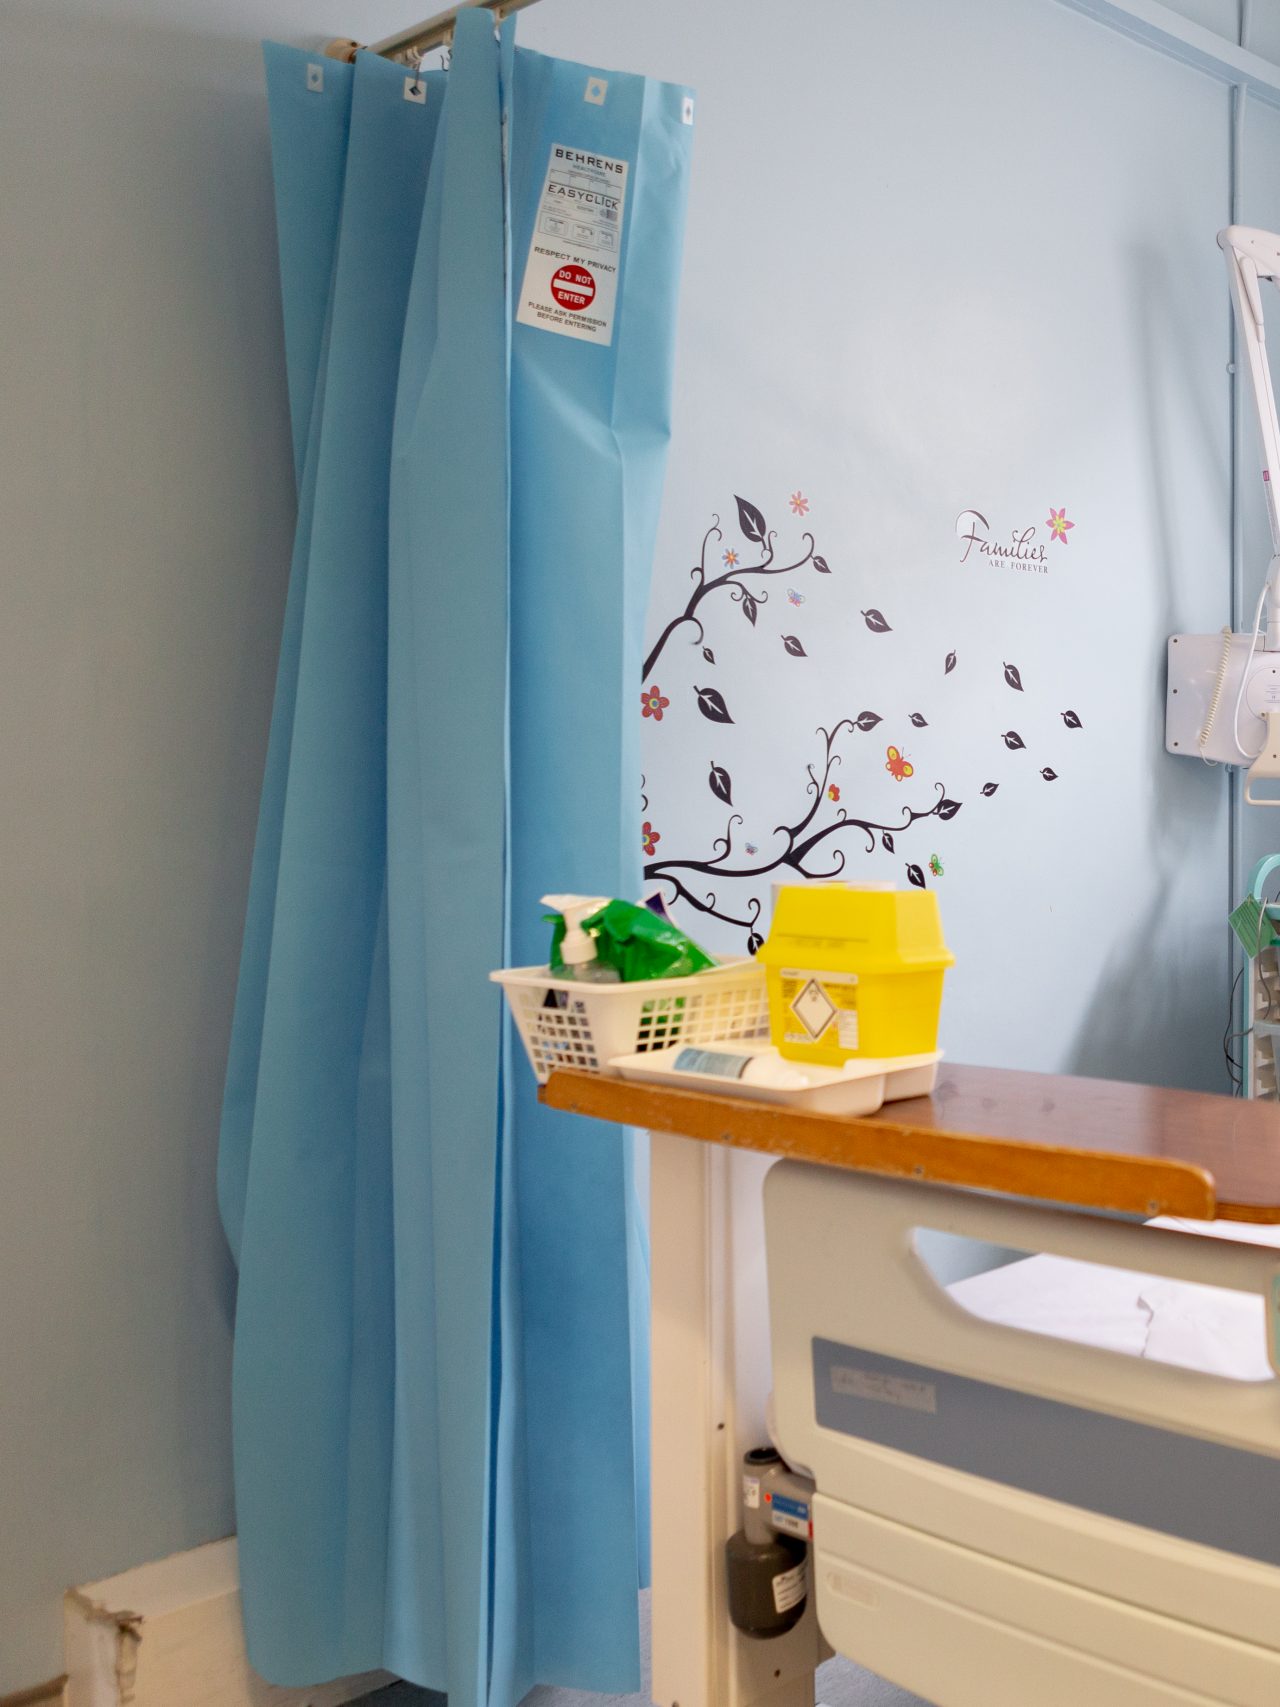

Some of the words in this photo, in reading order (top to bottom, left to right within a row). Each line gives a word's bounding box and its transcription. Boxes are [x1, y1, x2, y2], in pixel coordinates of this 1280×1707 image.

[555, 148, 624, 174] BEHRENS
[548, 184, 619, 210] EASYCLICK
[534, 246, 571, 261] RESPECT
[573, 256, 586, 265] MY
[587, 260, 617, 273] PRIVACY
[558, 270, 572, 280] DO
[575, 274, 592, 285] NOT
[558, 291, 586, 305] ENTER
[528, 301, 553, 314] PLEASE
[554, 309, 568, 318] ASK
[568, 312, 607, 328] PERMISSION
[536, 311, 563, 324] BEFORE
[564, 319, 597, 333] ENTERING
[955, 509, 1048, 563] Families
[988, 559, 1006, 569] ARE
[1010, 561, 1049, 574] FOREVER
